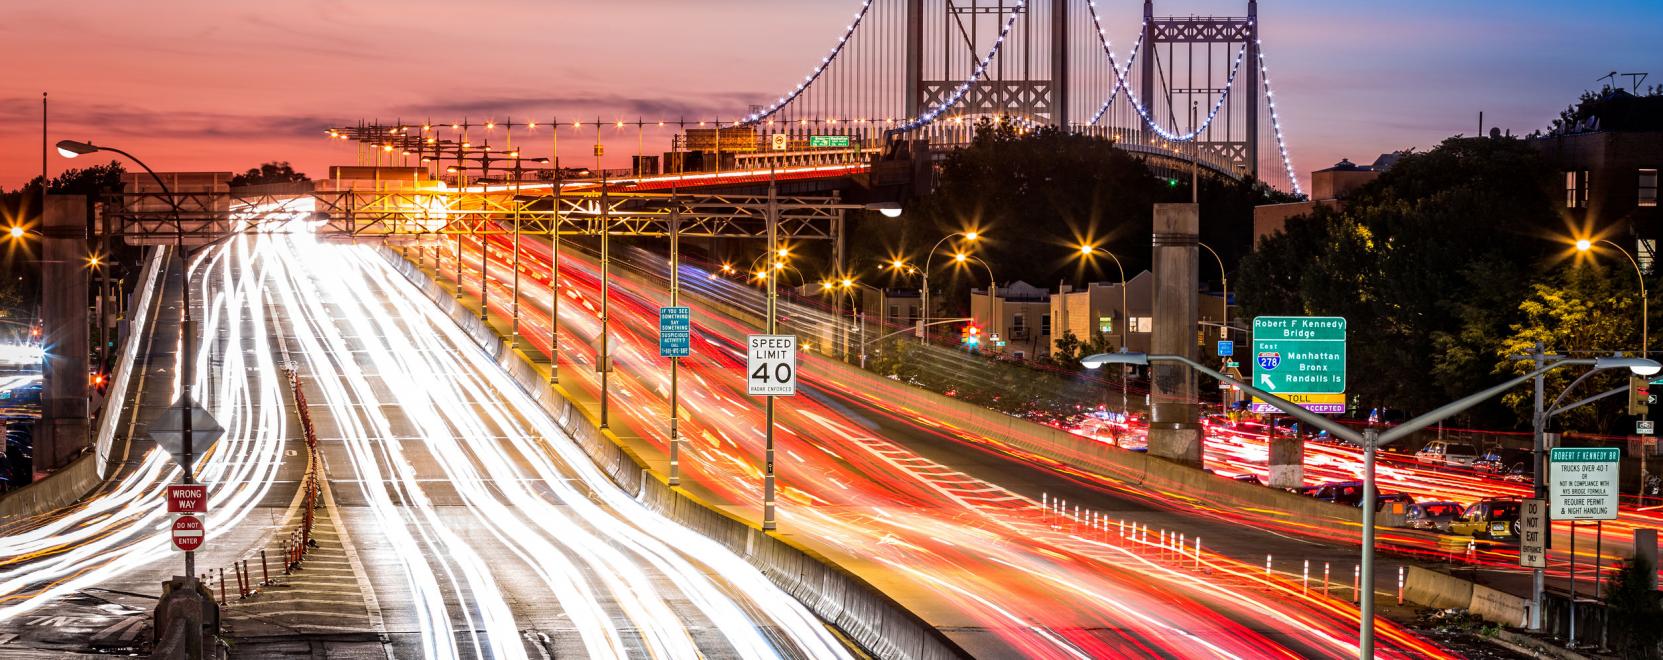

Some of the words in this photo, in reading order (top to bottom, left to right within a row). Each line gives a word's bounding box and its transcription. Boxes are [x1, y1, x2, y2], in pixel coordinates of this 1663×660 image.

[1255, 320, 1287, 328] Robert
[1302, 320, 1344, 329] Kennedy
[1284, 329, 1315, 338] Bridge
[752, 338, 792, 348] SPEED
[756, 350, 787, 360] LIMIT
[1288, 352, 1340, 360] Manhattan
[1261, 358, 1278, 367] 278
[1300, 364, 1328, 372] Bronx
[752, 362, 792, 384] 40
[1286, 374, 1328, 382] Randalls
[1288, 394, 1312, 402] TOLL
[1554, 451, 1575, 460] ROBERT
[1576, 452, 1580, 460] F
[1582, 452, 1607, 460] KENNEDY
[1608, 452, 1616, 460] BR
[172, 490, 202, 498] WRONG
[178, 500, 196, 508] WAY
[1528, 504, 1538, 514] DO
[1527, 517, 1538, 528] NOT
[1526, 531, 1538, 542] EXIT
